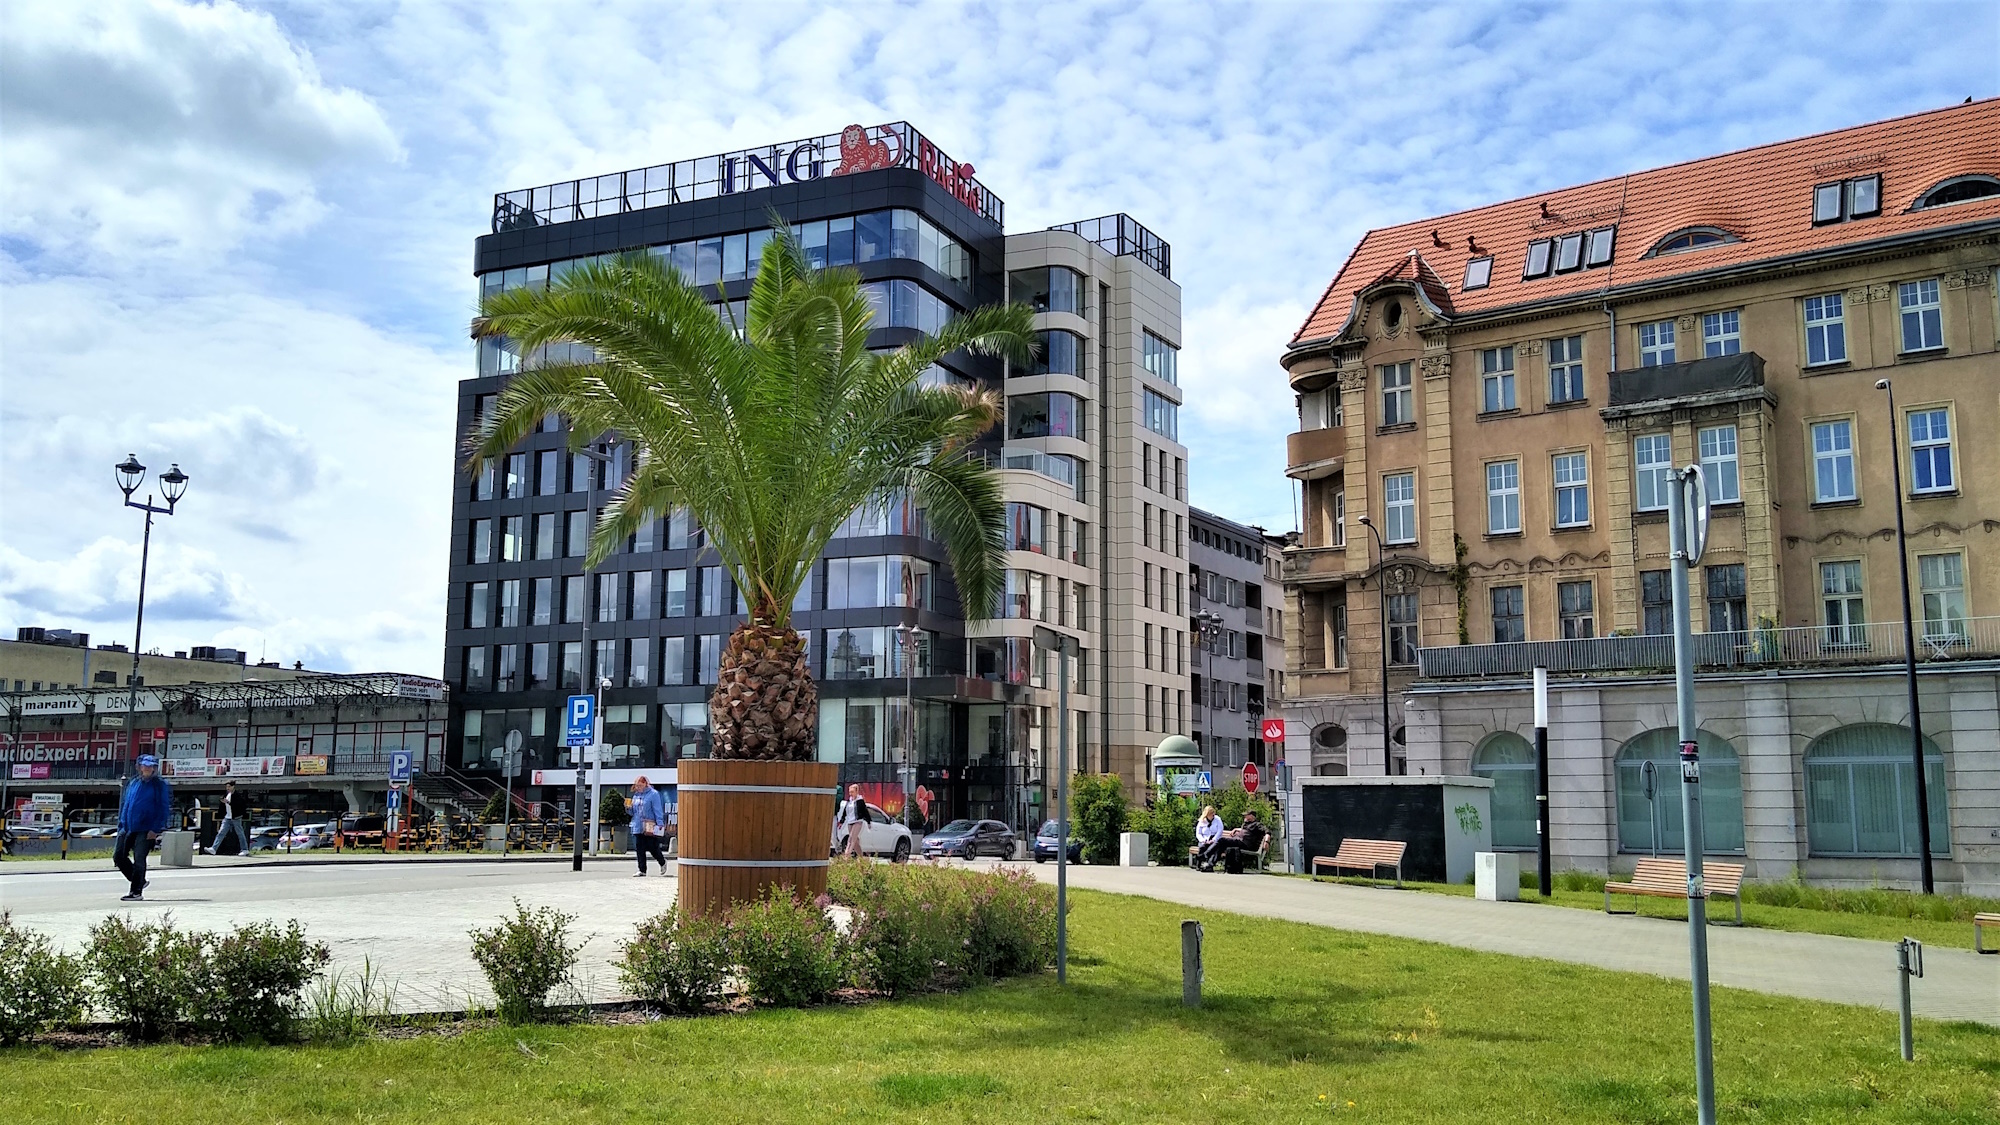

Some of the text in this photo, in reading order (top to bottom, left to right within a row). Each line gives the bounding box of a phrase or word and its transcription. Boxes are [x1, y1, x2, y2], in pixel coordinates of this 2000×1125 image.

[720, 141, 824, 197] ING
[25, 699, 78, 710] marantz
[200, 695, 315, 709] Personnel International
[573, 699, 589, 726] P
[0, 743, 113, 765] udioExpert.pl
[393, 754, 408, 777] P
[1244, 773, 1258, 783] STOP
